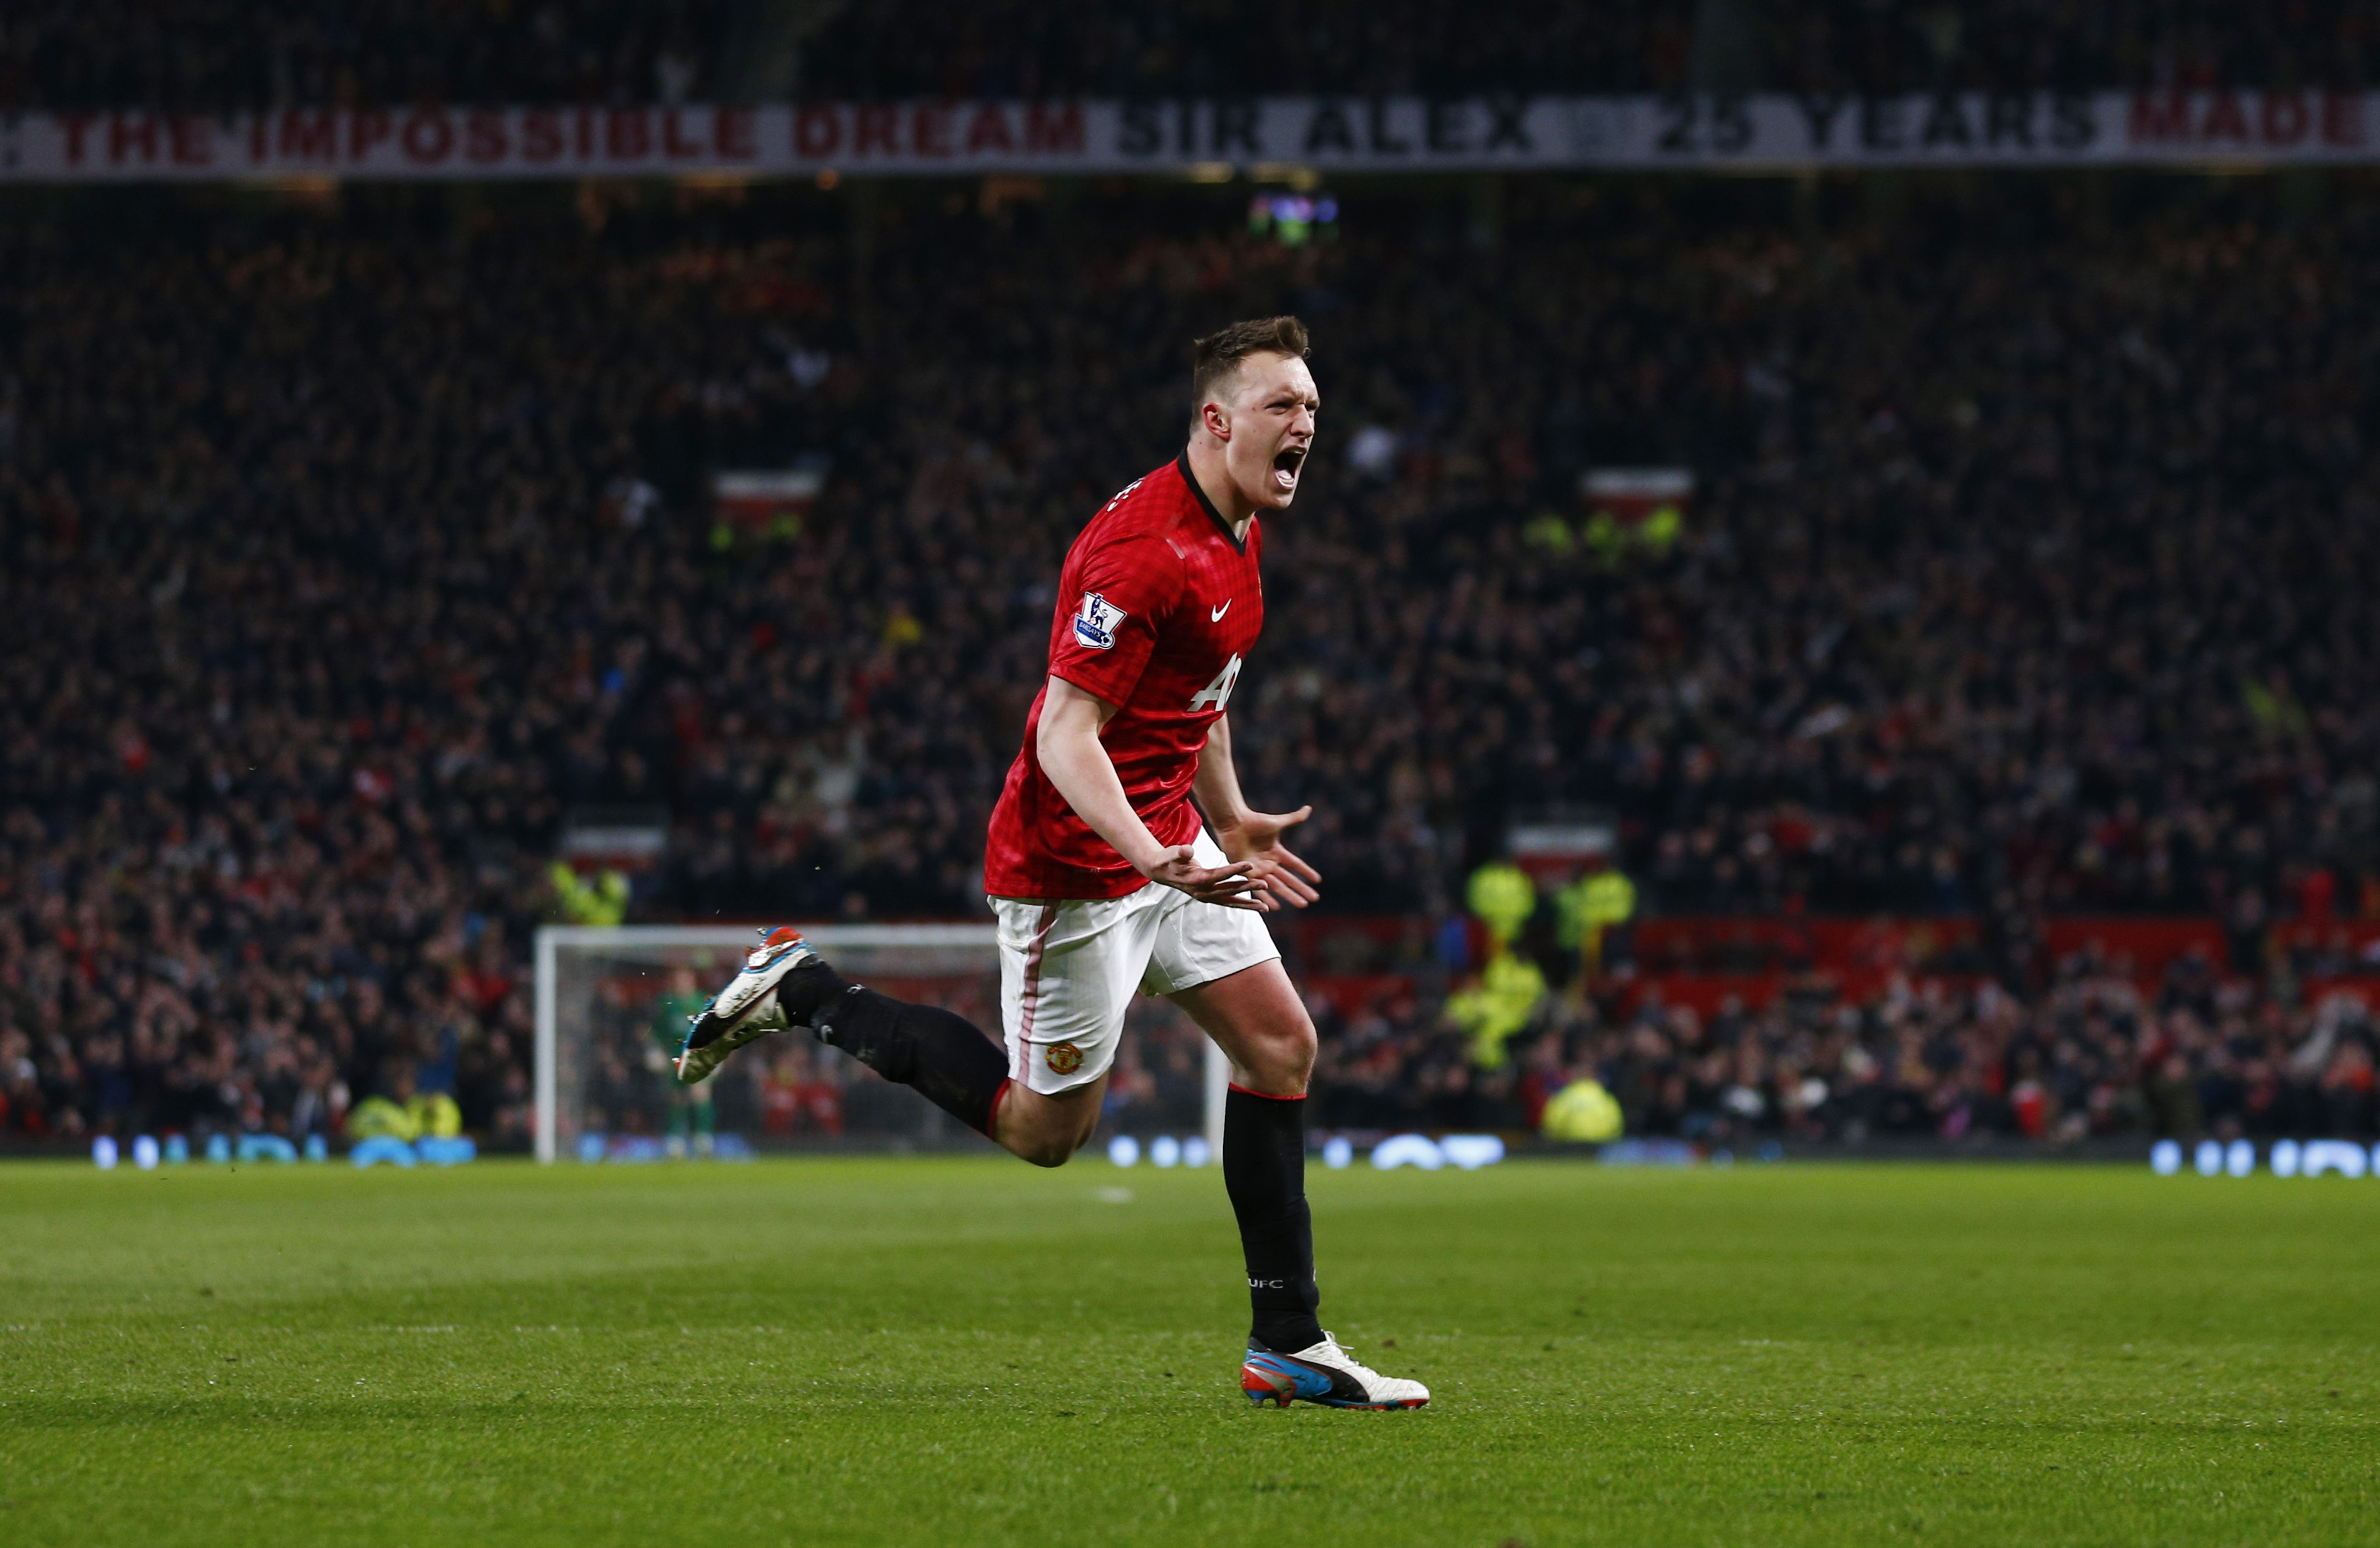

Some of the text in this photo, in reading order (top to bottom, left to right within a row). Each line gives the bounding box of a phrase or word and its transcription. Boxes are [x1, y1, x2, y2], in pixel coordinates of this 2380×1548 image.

[54, 113, 217, 167] THE
[249, 106, 757, 165] IMPOSSIBLE
[793, 103, 1087, 159] DREAM
[1116, 99, 1263, 158] SIR
[1303, 95, 1536, 155] ALEX
[1656, 91, 1754, 154] 25
[1793, 90, 2098, 152] YEARS
[2126, 89, 2369, 148] MADE
